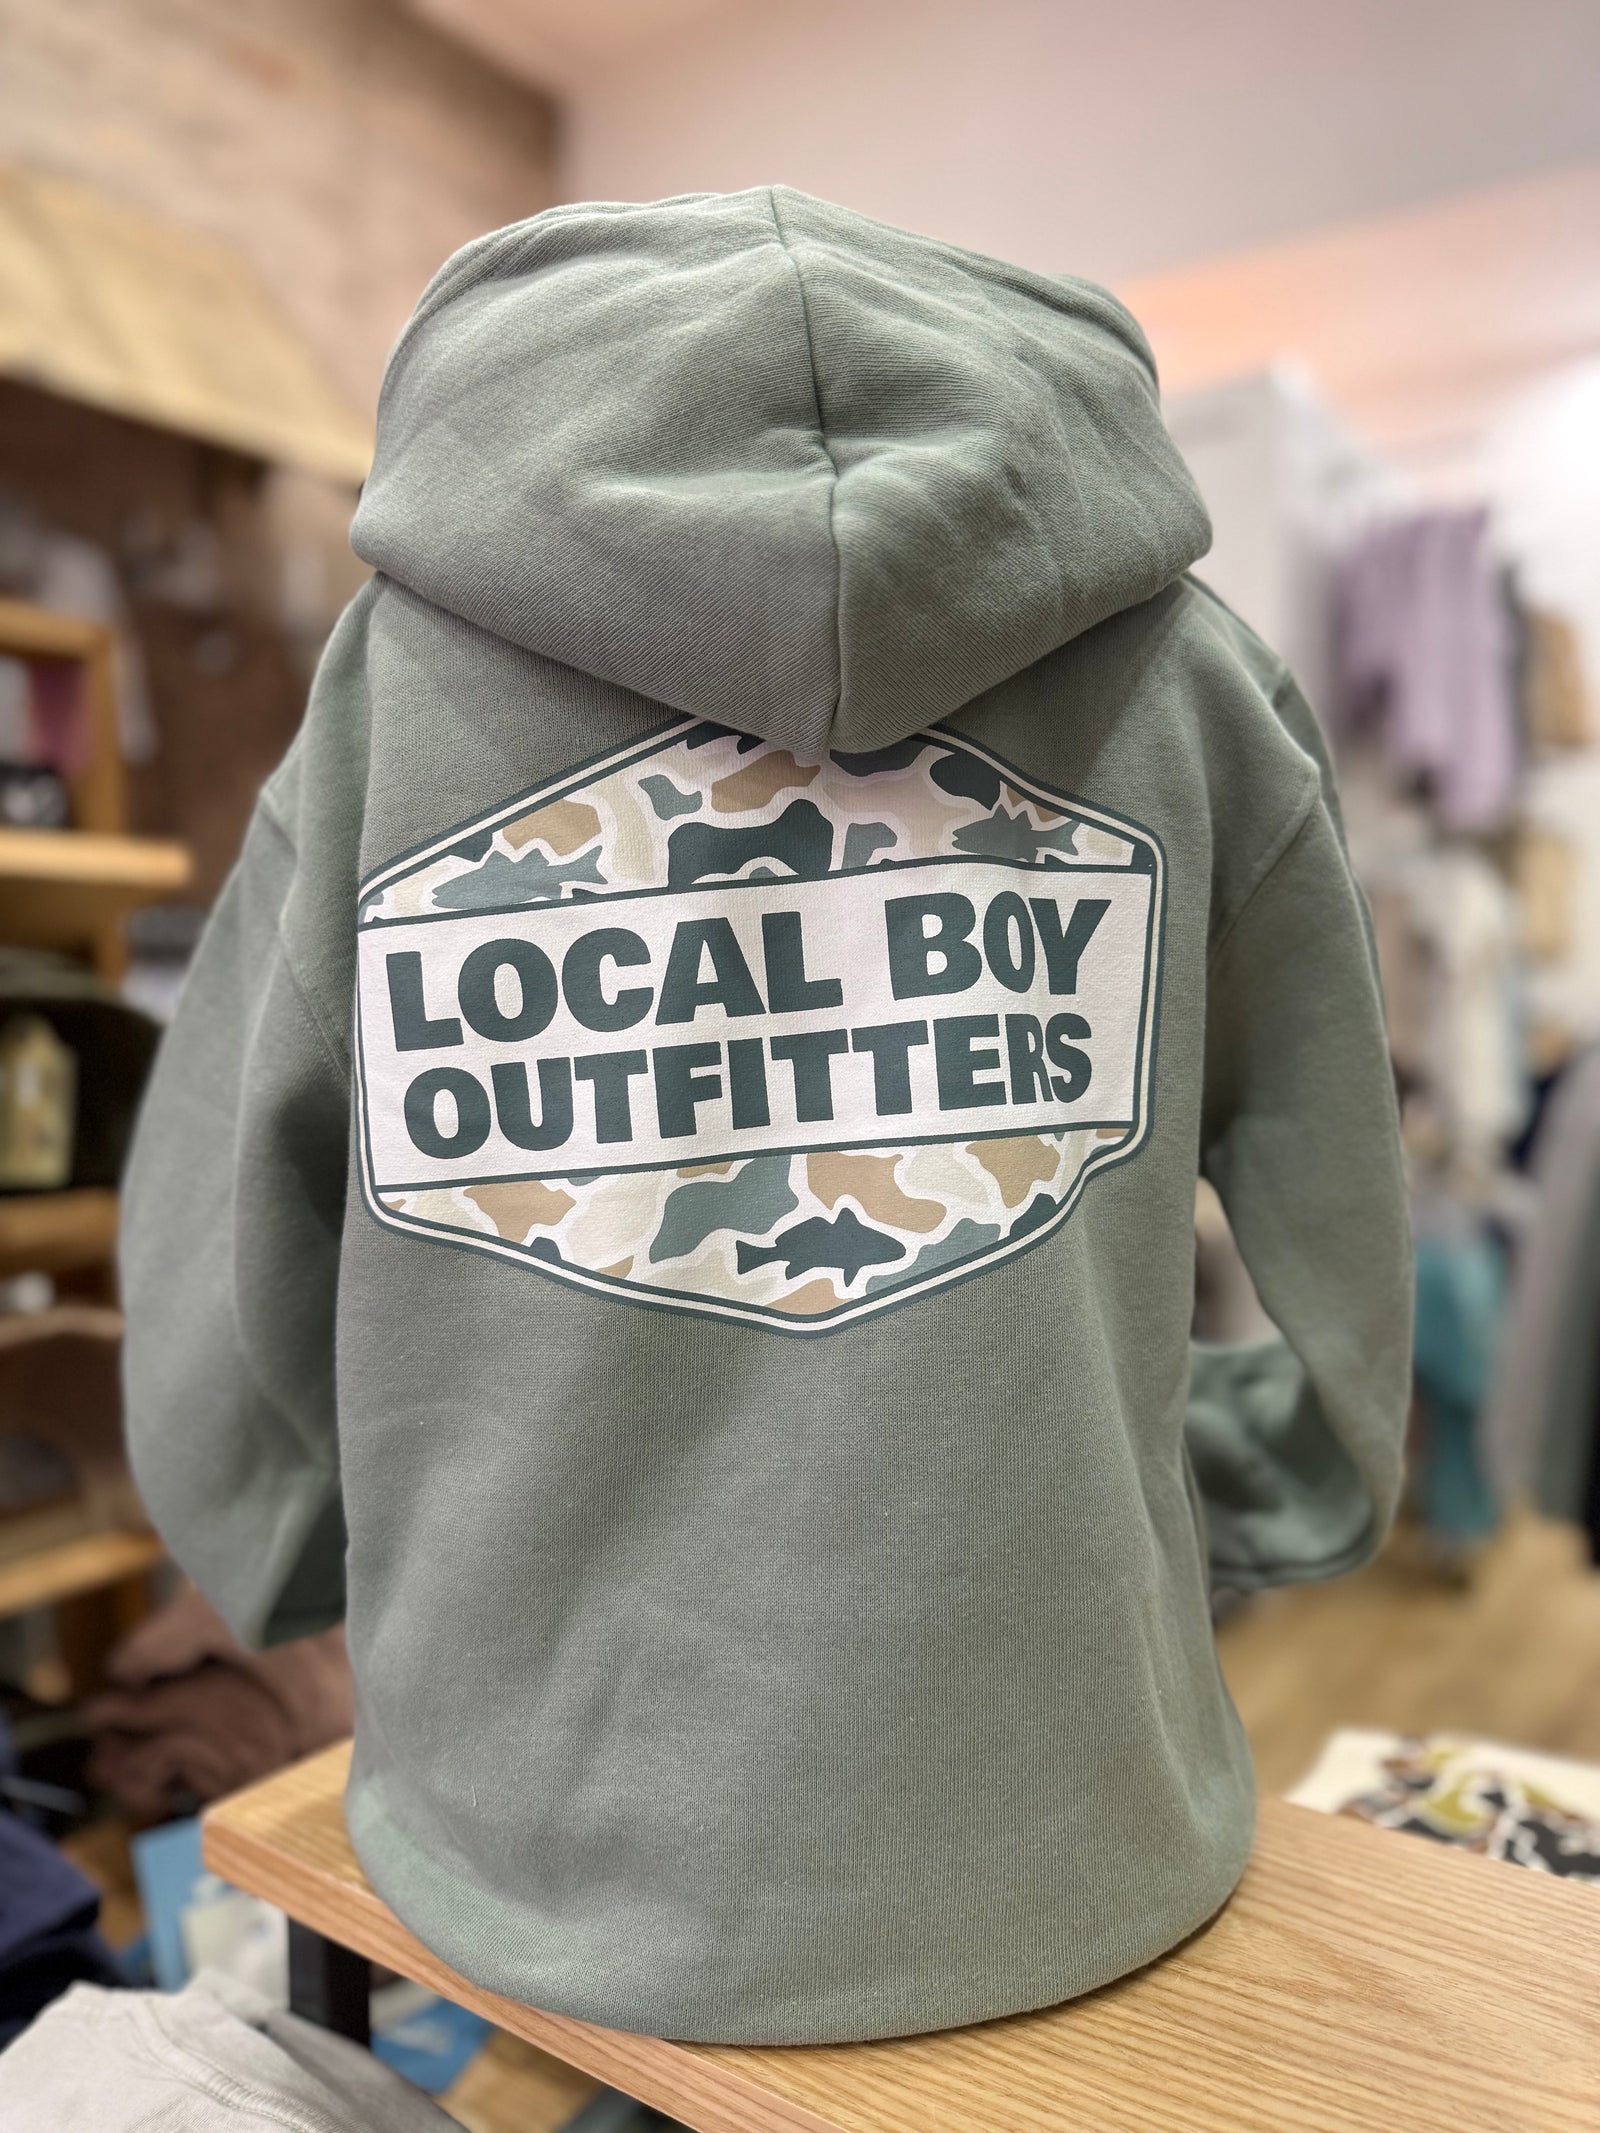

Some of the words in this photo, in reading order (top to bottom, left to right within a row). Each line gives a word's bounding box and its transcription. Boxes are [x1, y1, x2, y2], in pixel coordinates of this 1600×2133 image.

[386, 911, 843, 1052] LOCAL
[884, 890, 1112, 1000] BOY
[404, 1012, 1093, 1160] OUTFITTERS
